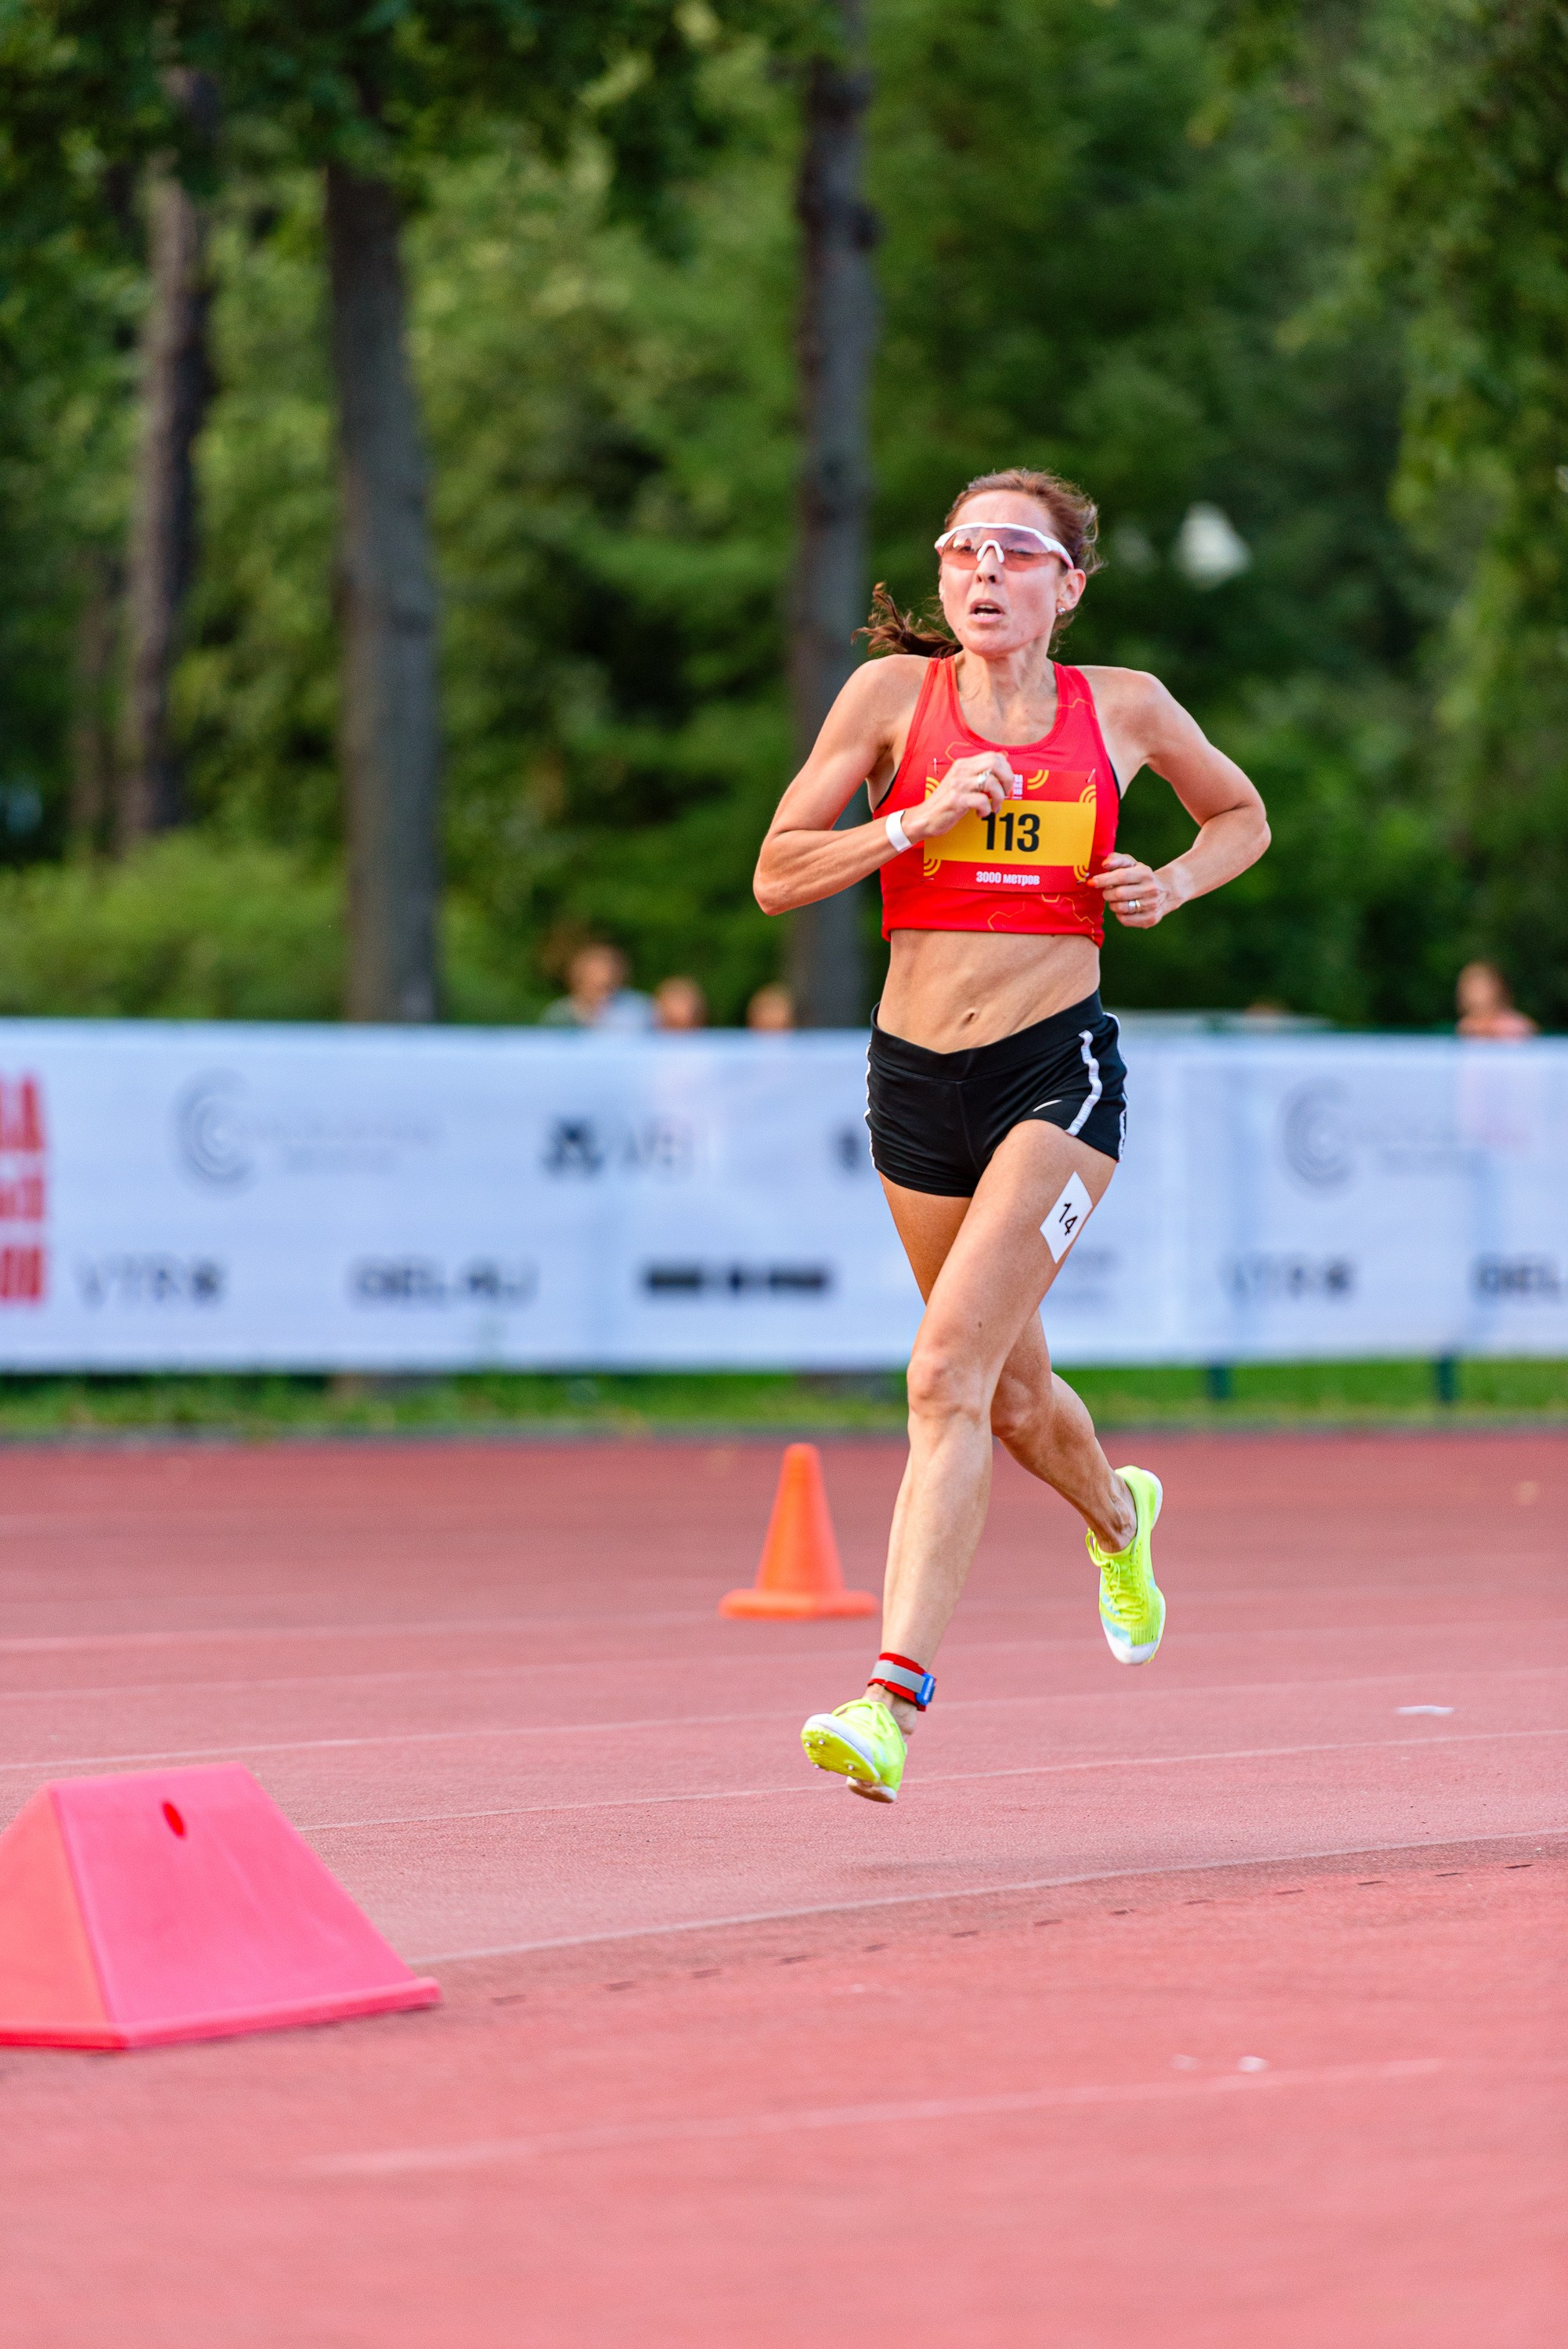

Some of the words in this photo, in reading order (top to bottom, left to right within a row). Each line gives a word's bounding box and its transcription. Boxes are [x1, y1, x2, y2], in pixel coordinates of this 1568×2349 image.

[981, 811, 1040, 853] 113
[975, 871, 1002, 884] 3000
[1002, 874, 1040, 886] метров
[1058, 1203, 1078, 1236] 14
